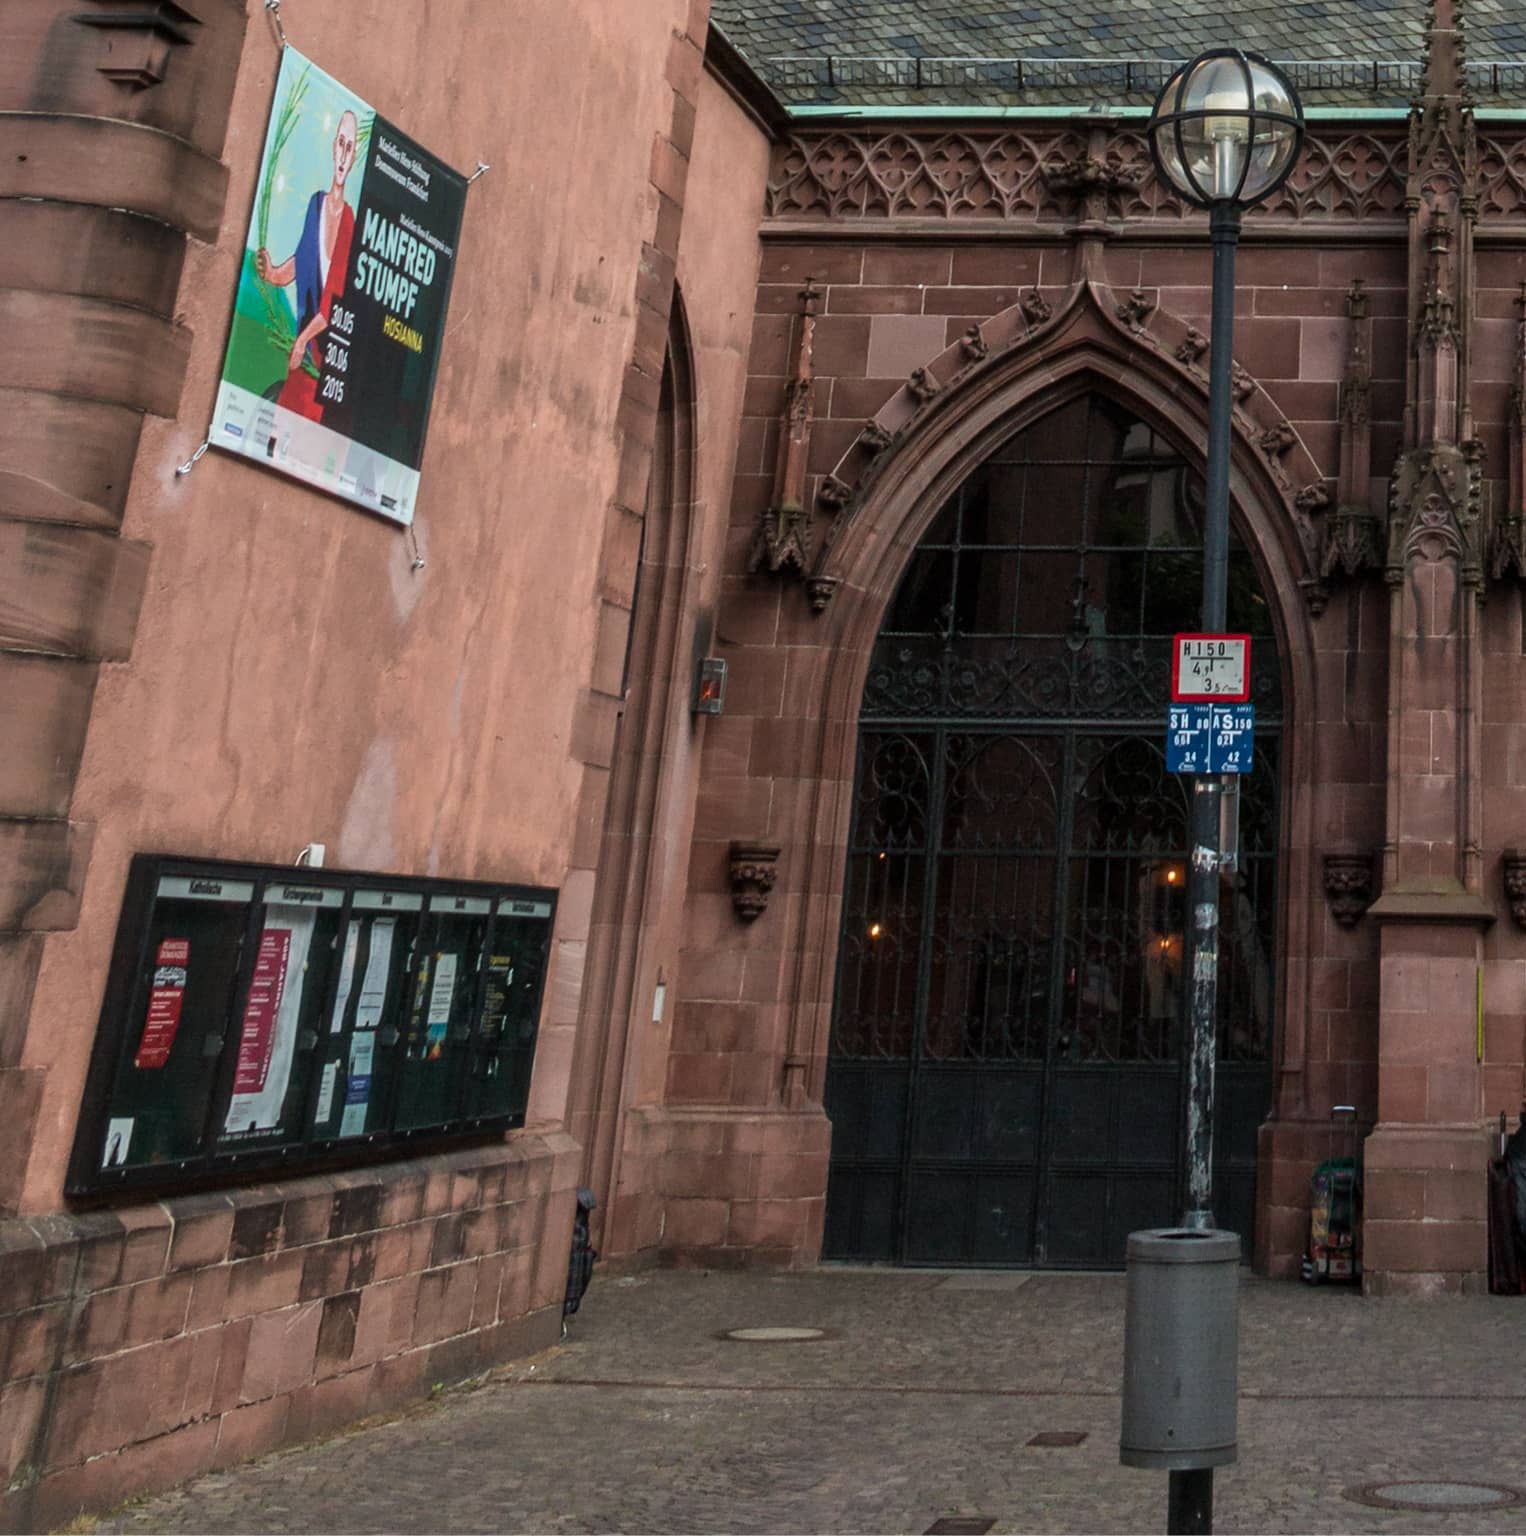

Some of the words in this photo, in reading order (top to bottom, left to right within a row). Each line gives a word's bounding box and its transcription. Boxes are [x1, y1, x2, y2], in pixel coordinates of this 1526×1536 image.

[361, 207, 436, 287] MANFRED
[354, 252, 419, 320] STUMPF
[330, 304, 355, 335] 30.05
[382, 314, 424, 354] HOSIANNA
[324, 342, 349, 373] 30.06
[322, 375, 345, 403] 2015
